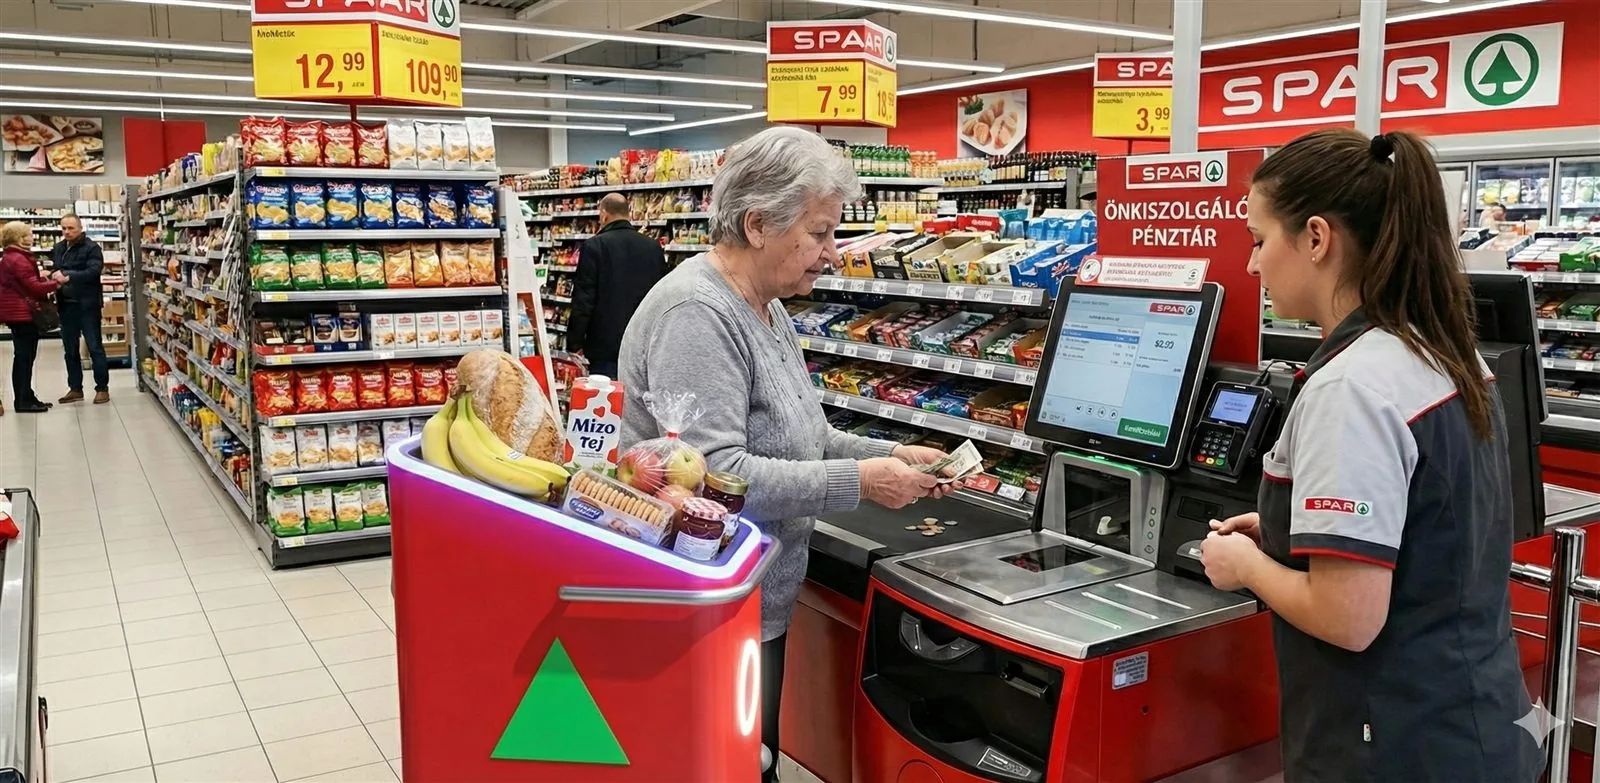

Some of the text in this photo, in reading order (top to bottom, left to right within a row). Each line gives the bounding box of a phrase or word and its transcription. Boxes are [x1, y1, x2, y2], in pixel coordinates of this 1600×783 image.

[1222, 55, 1439, 116] SPAR
[1142, 165, 1200, 182] SPAR
[1104, 195, 1249, 221] ÖNKISZOLGÁLÓ
[1132, 224, 1217, 247] PÉNZTÁR
[1156, 304, 1185, 313] SPAR
[572, 418, 616, 435] Mizo
[580, 435, 605, 452] Tej
[1314, 500, 1354, 512] SPAR
